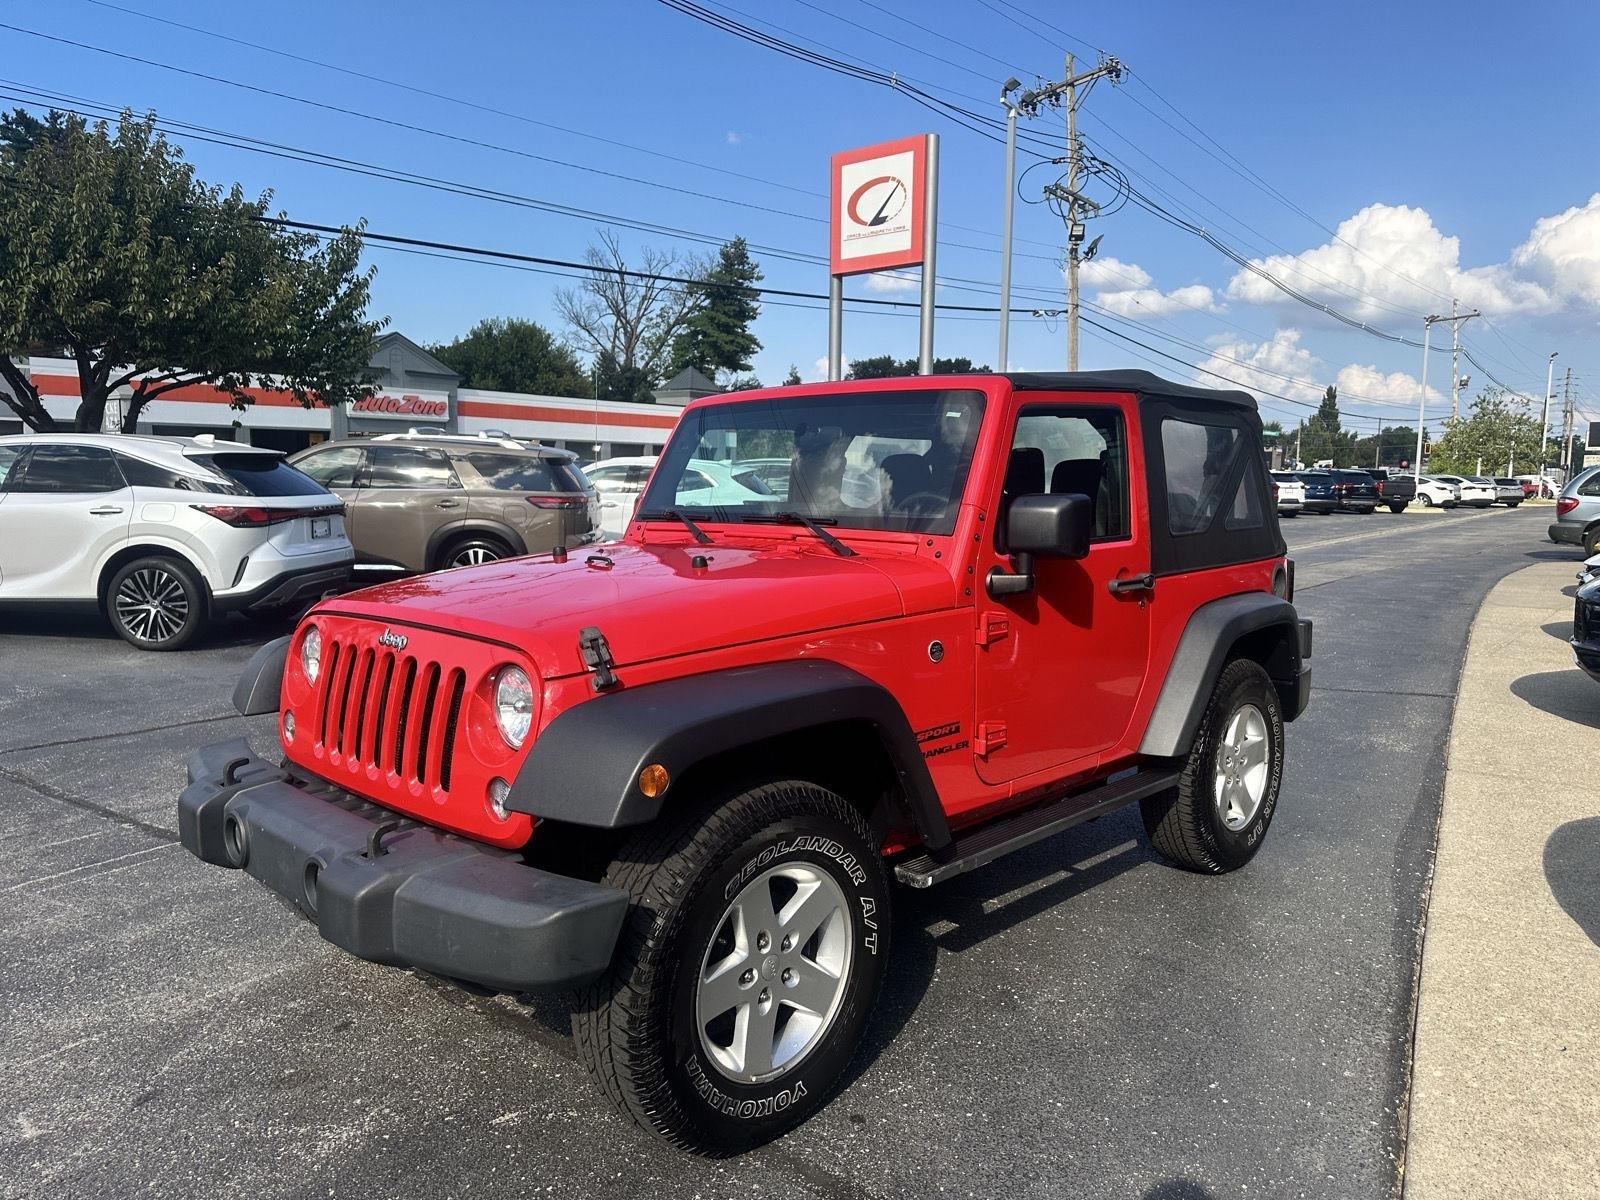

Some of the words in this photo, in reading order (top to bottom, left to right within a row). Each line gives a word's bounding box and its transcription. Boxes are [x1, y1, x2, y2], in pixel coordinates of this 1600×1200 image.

[352, 394, 448, 416] AutoZone
[379, 627, 408, 653] Jeep
[916, 723, 960, 741] SPORT
[725, 836, 867, 900] GEOLANDAR
[860, 897, 878, 955] A/T
[685, 1054, 808, 1119] YOKOHAMA
